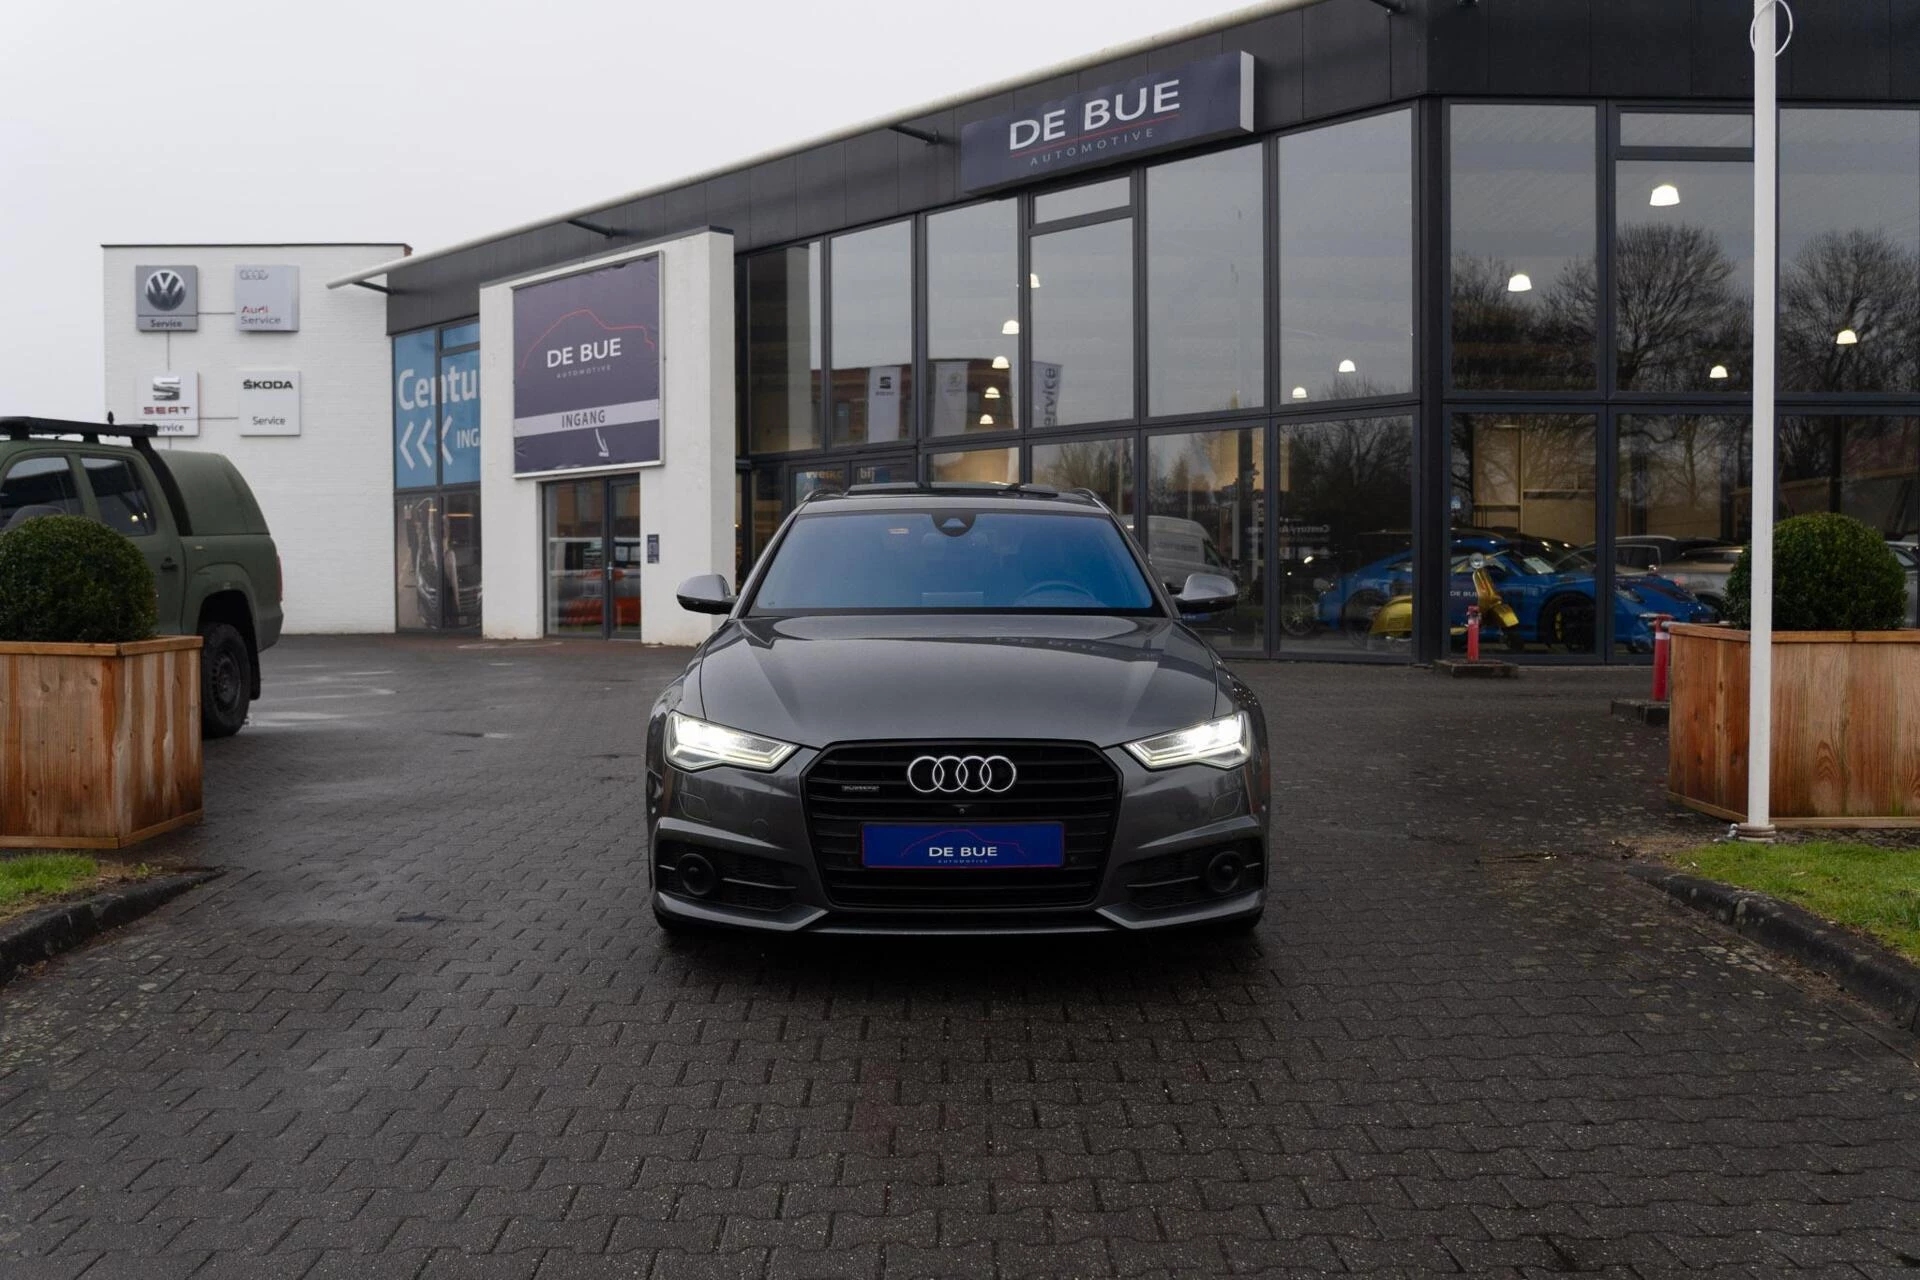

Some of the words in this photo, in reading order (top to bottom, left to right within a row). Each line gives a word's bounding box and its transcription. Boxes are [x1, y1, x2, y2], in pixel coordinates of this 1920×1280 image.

[1009, 109, 1066, 151] DE
[1084, 79, 1181, 131] BUE
[1029, 127, 1155, 167] AUTOMOTIVE
[241, 305, 269, 315] Audi
[150, 319, 183, 329] Service
[241, 316, 282, 326] Service
[547, 346, 574, 369] DE
[580, 337, 622, 360] BUE
[556, 364, 612, 379] AUTOMOTIVE
[243, 379, 294, 390] ŠKODA
[143, 406, 190, 415] SEAT
[252, 416, 286, 427] Service
[561, 410, 606, 429] INGANG
[928, 846, 954, 857] DE
[960, 846, 998, 857] BUE
